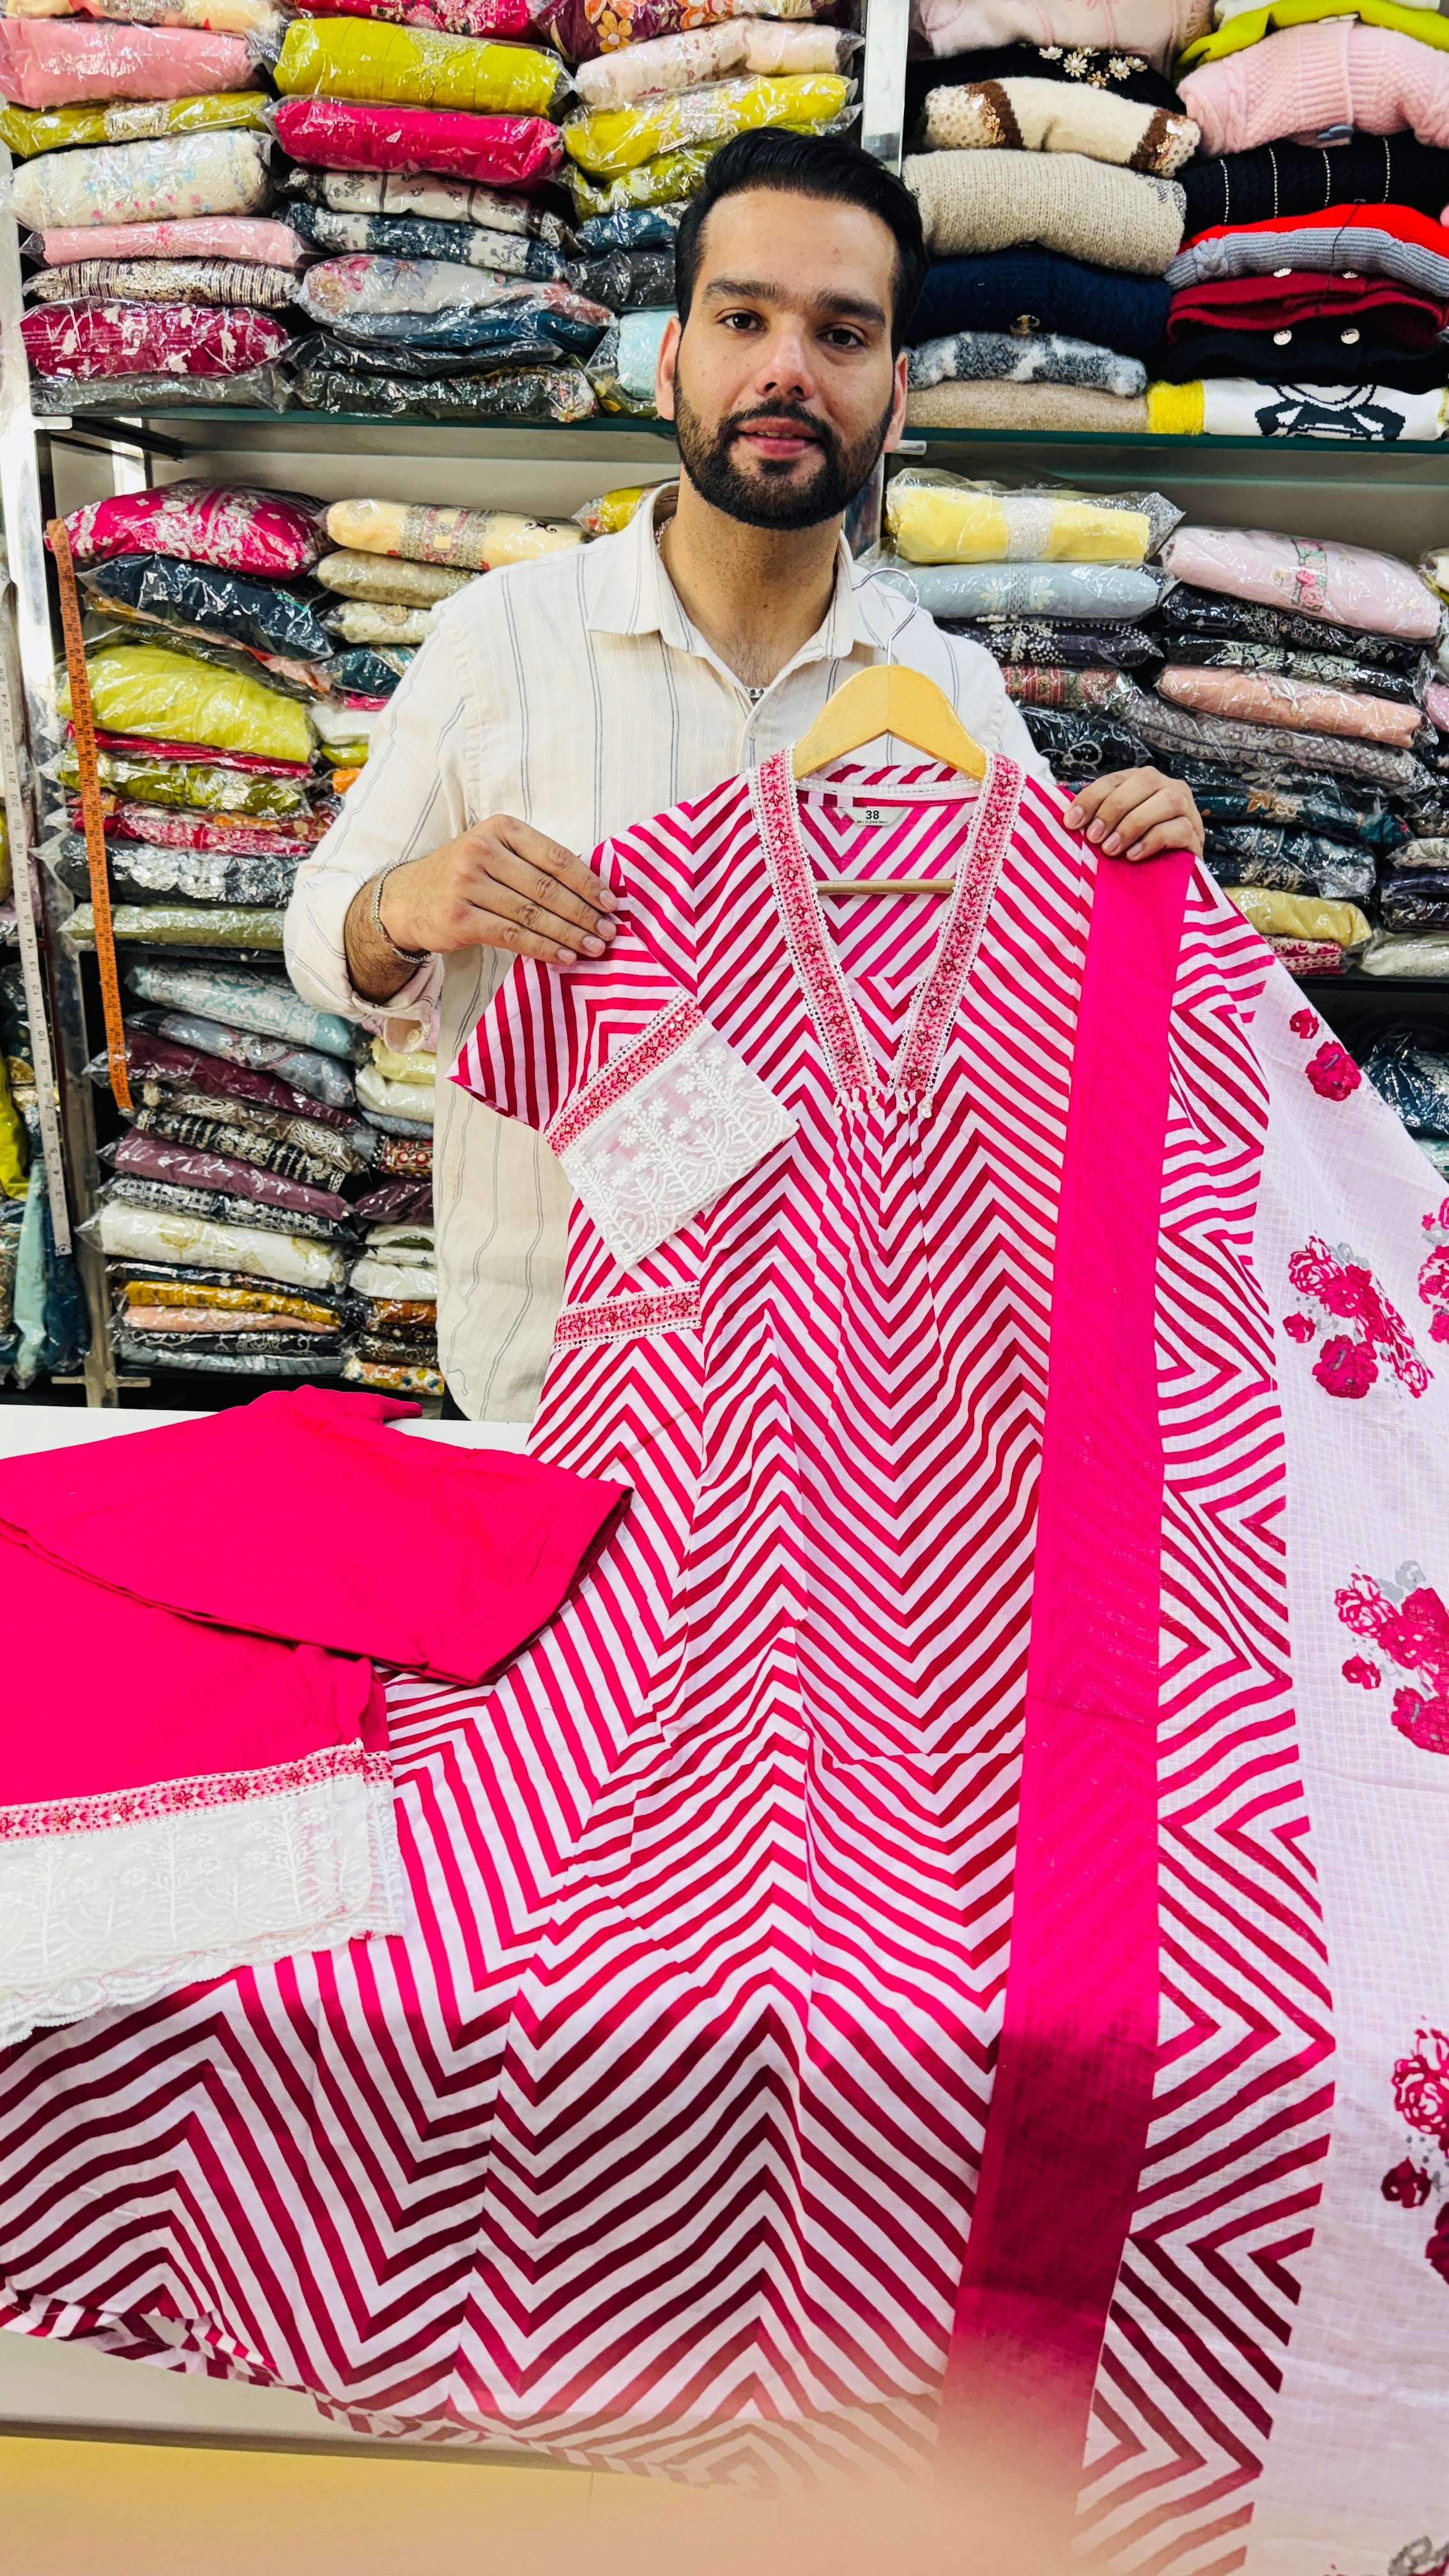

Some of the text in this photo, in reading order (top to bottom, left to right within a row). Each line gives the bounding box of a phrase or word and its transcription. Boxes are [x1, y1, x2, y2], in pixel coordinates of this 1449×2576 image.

[0, 668, 5, 682] 25
[1, 694, 8, 707] 24
[4, 719, 10, 732] 23
[6, 744, 13, 758] 22
[9, 772, 15, 783] 21
[11, 794, 19, 807] 20
[866, 810, 879, 819] 38
[16, 843, 23, 854] 18
[19, 868, 26, 878] 17
[21, 891, 27, 902] 16
[24, 914, 31, 924] 15
[27, 939, 34, 949] 14
[30, 962, 36, 972] 13
[33, 985, 40, 995] 12
[36, 1009, 42, 1019] 11
[38, 1031, 45, 1041] 10
